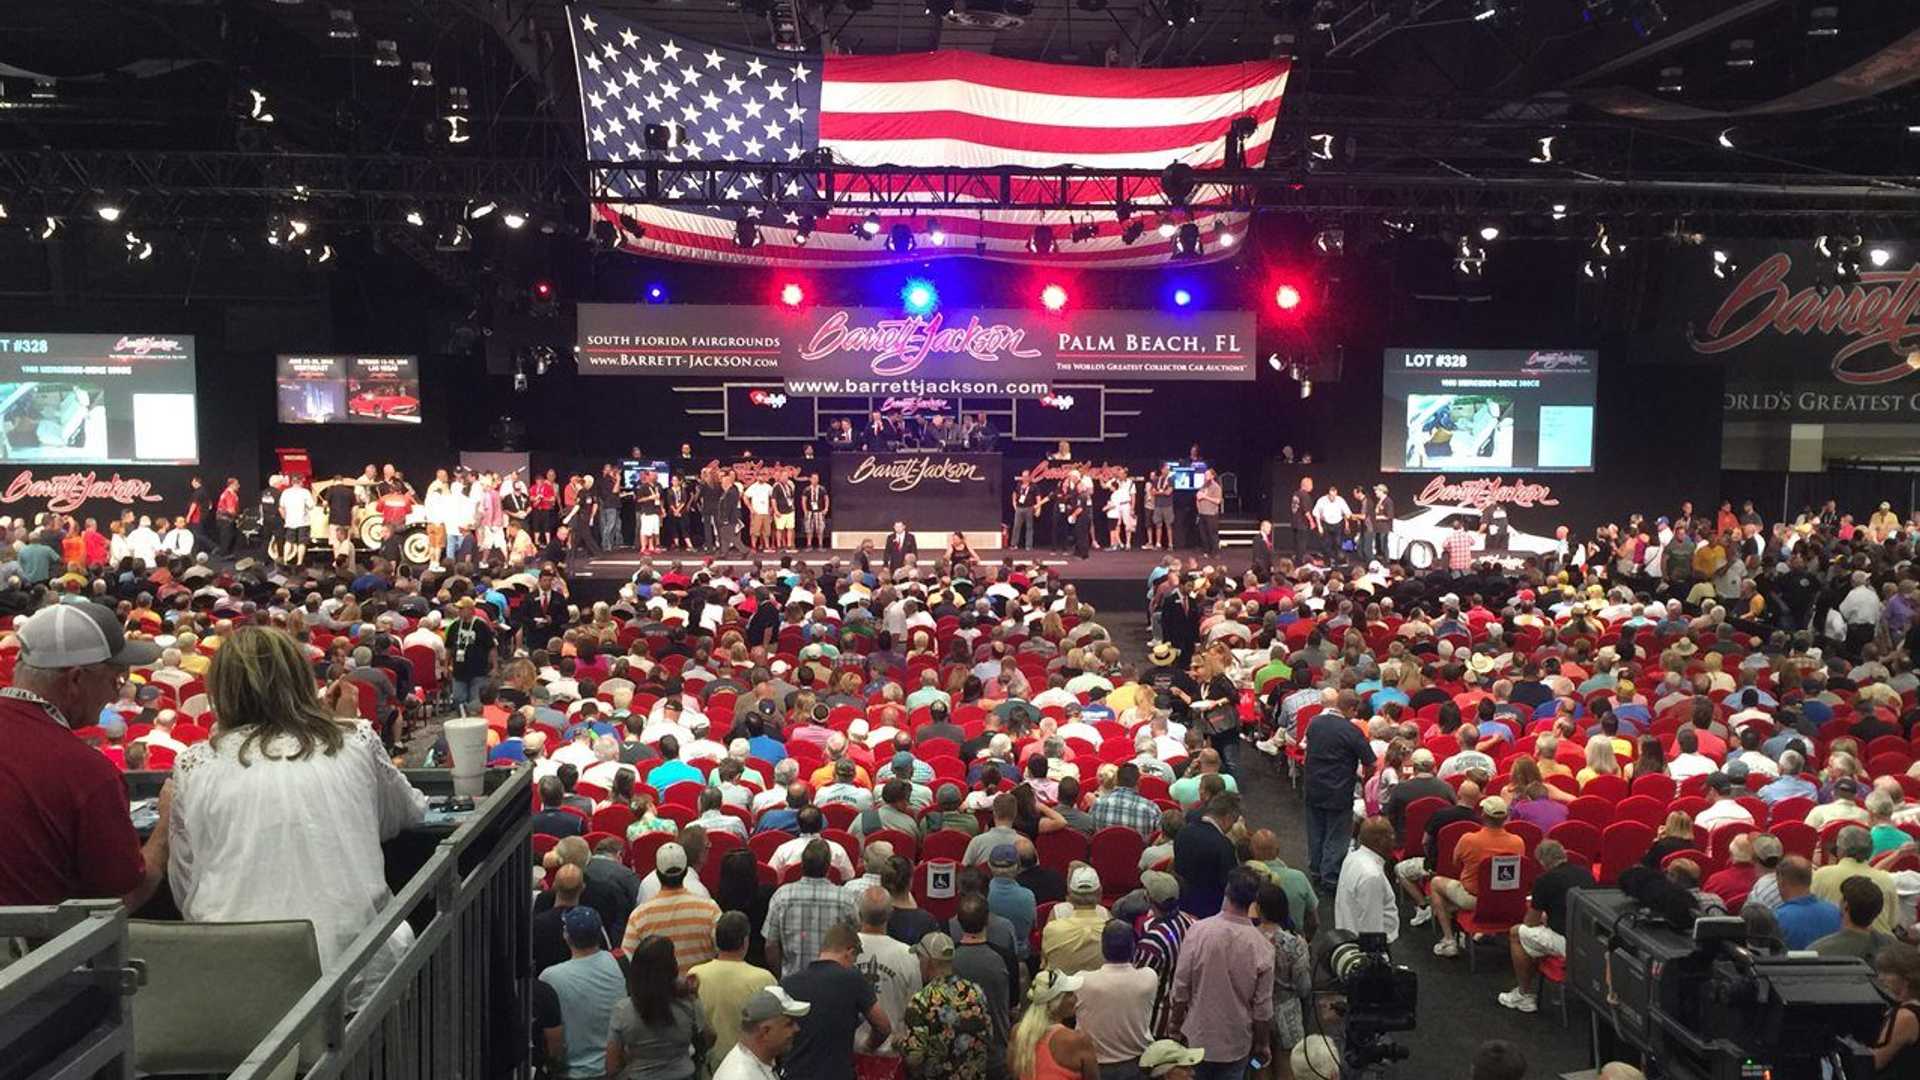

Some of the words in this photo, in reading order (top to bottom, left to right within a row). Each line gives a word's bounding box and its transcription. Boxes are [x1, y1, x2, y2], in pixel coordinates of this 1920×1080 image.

[1686, 252, 1920, 385] Barrett
[13, 339, 48, 353] #328
[587, 335, 630, 346] SOUTH
[634, 336, 688, 347] FLORIDA
[691, 336, 781, 348] FAIRGROUNDS
[798, 310, 1042, 376] Barrett-Jackson
[1058, 333, 1117, 351] PALM
[1126, 333, 1206, 353] BEACH,
[1215, 333, 1240, 352] FL
[1057, 362, 1071, 371] THE
[1106, 362, 1143, 371] GREATEST
[1144, 363, 1187, 372] COLLECTOR
[1188, 363, 1204, 372] CAR
[1405, 354, 1433, 368] LOT
[1435, 354, 1468, 368] #328
[788, 378, 1049, 398] www.barrett-jackson.com
[1724, 391, 1792, 411] ORLD'S
[1798, 391, 1904, 411] GREATEST
[848, 455, 986, 491] Barrett-Jackson
[0, 469, 163, 512] Barrett-Jackson
[1414, 474, 1560, 508] Barrett-Jackson
